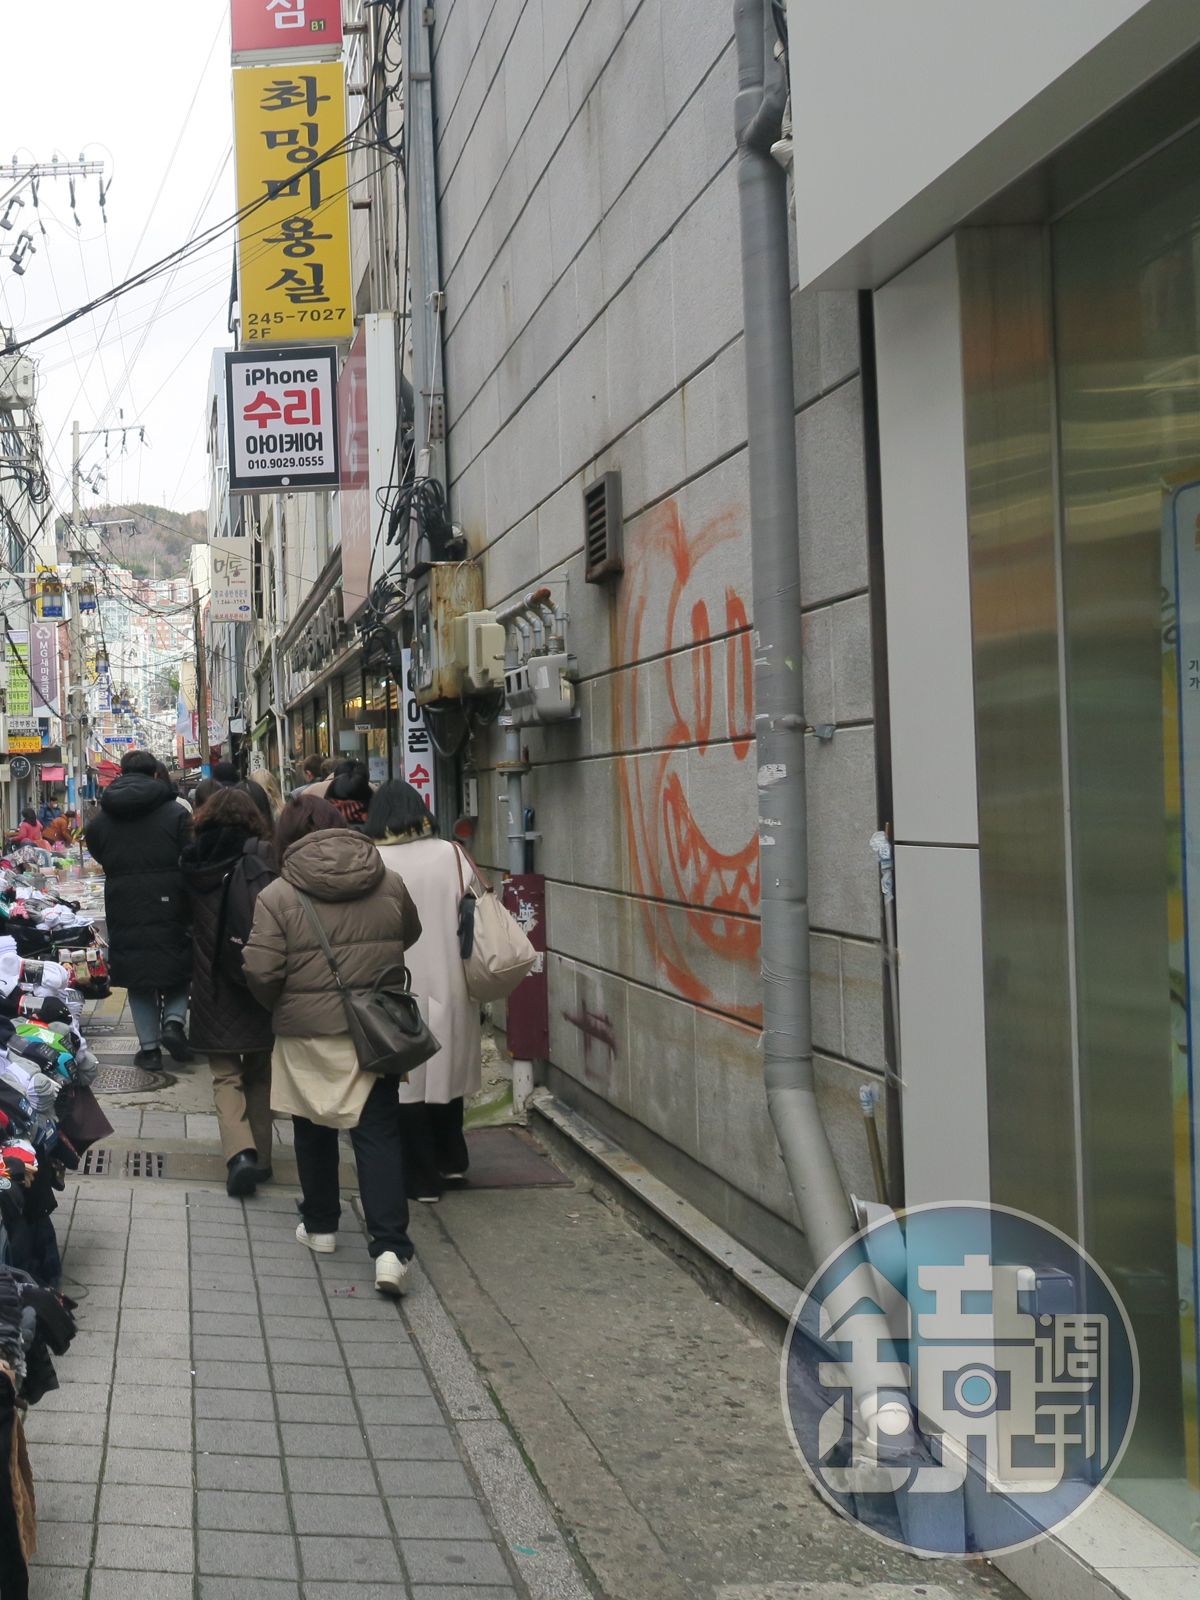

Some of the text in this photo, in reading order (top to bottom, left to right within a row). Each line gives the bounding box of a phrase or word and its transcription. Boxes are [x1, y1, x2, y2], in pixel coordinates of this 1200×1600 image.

[311, 20, 325, 32] B1
[247, 308, 347, 326] 245-7027
[248, 328, 272, 340] 2F
[245, 366, 318, 385] iPhone
[243, 387, 322, 429] 수리
[245, 431, 323, 456] 아이케어
[247, 455, 325, 471] 010.9029.0555
